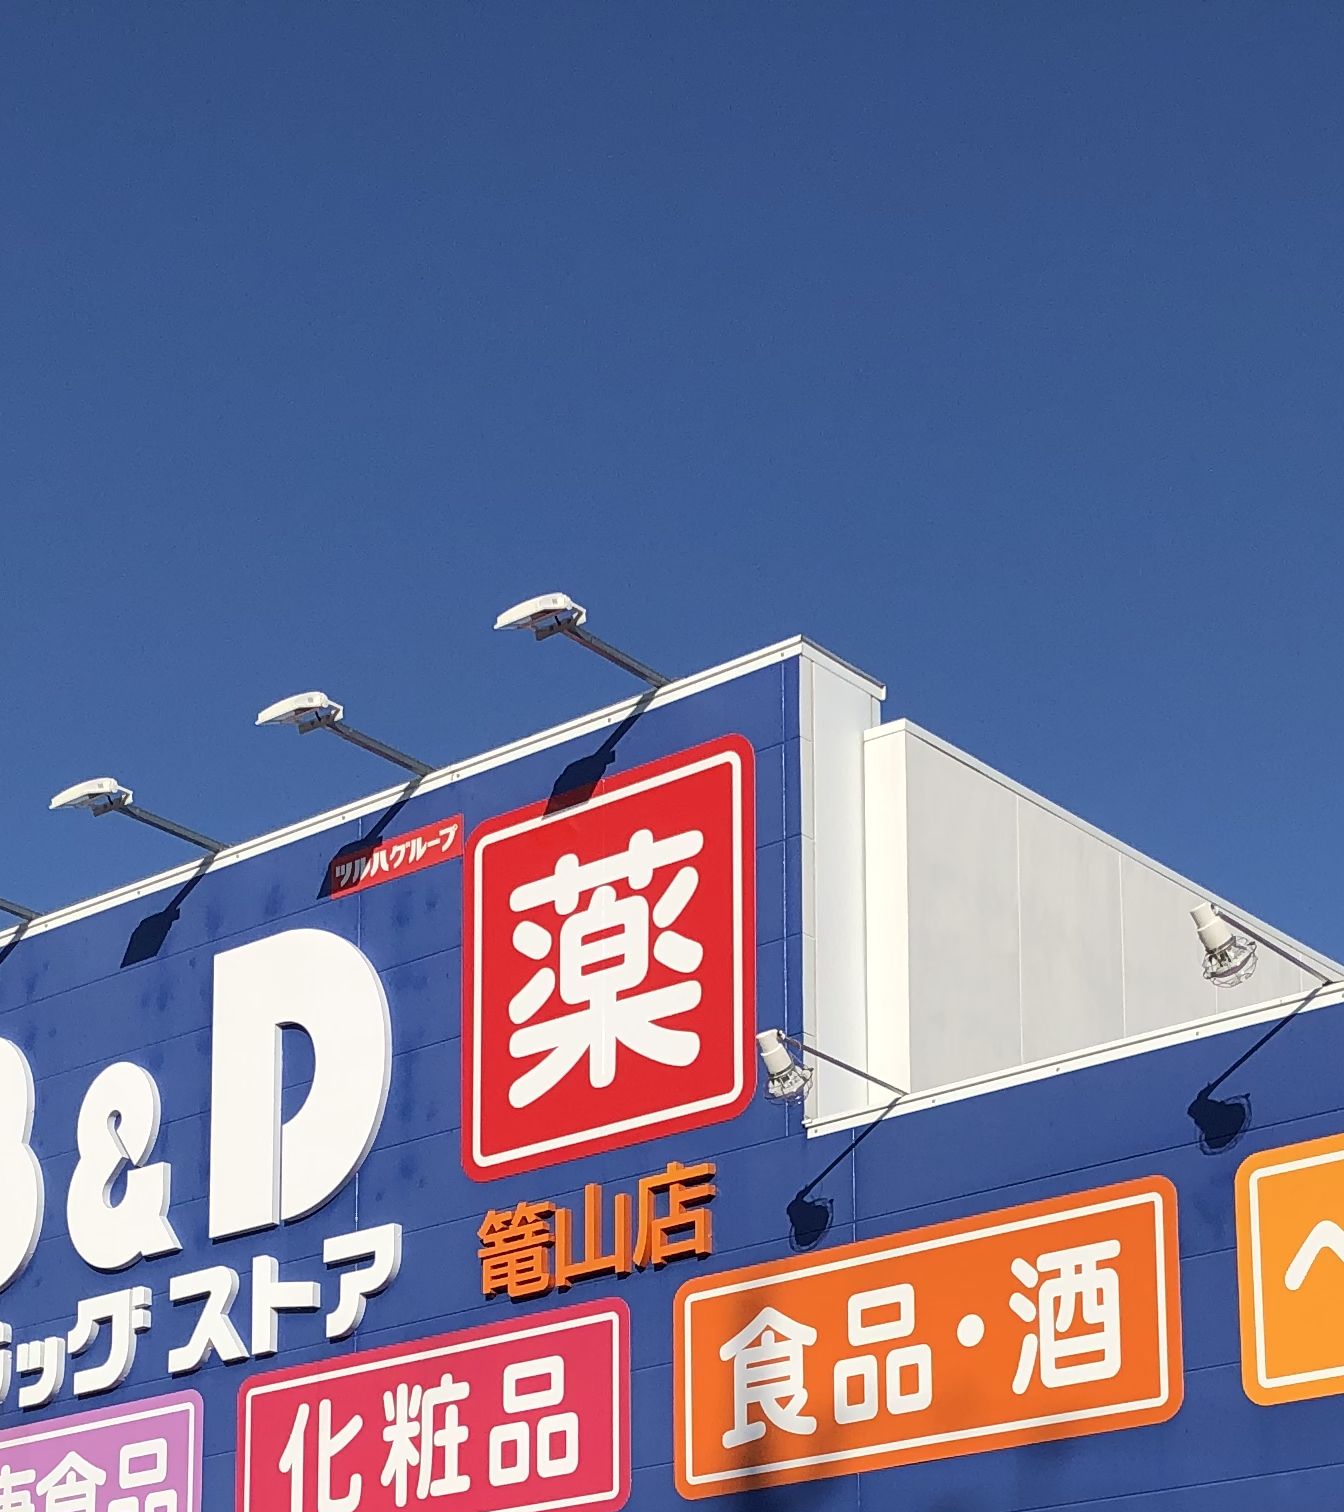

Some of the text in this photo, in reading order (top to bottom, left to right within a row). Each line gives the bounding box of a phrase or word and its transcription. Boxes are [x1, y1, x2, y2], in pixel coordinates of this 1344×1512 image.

[335, 823, 459, 888] ツルハグループ
[508, 828, 707, 1111] 薬
[476, 1161, 717, 1303] 篭山店
[719, 1239, 1122, 1450] 食品・酒
